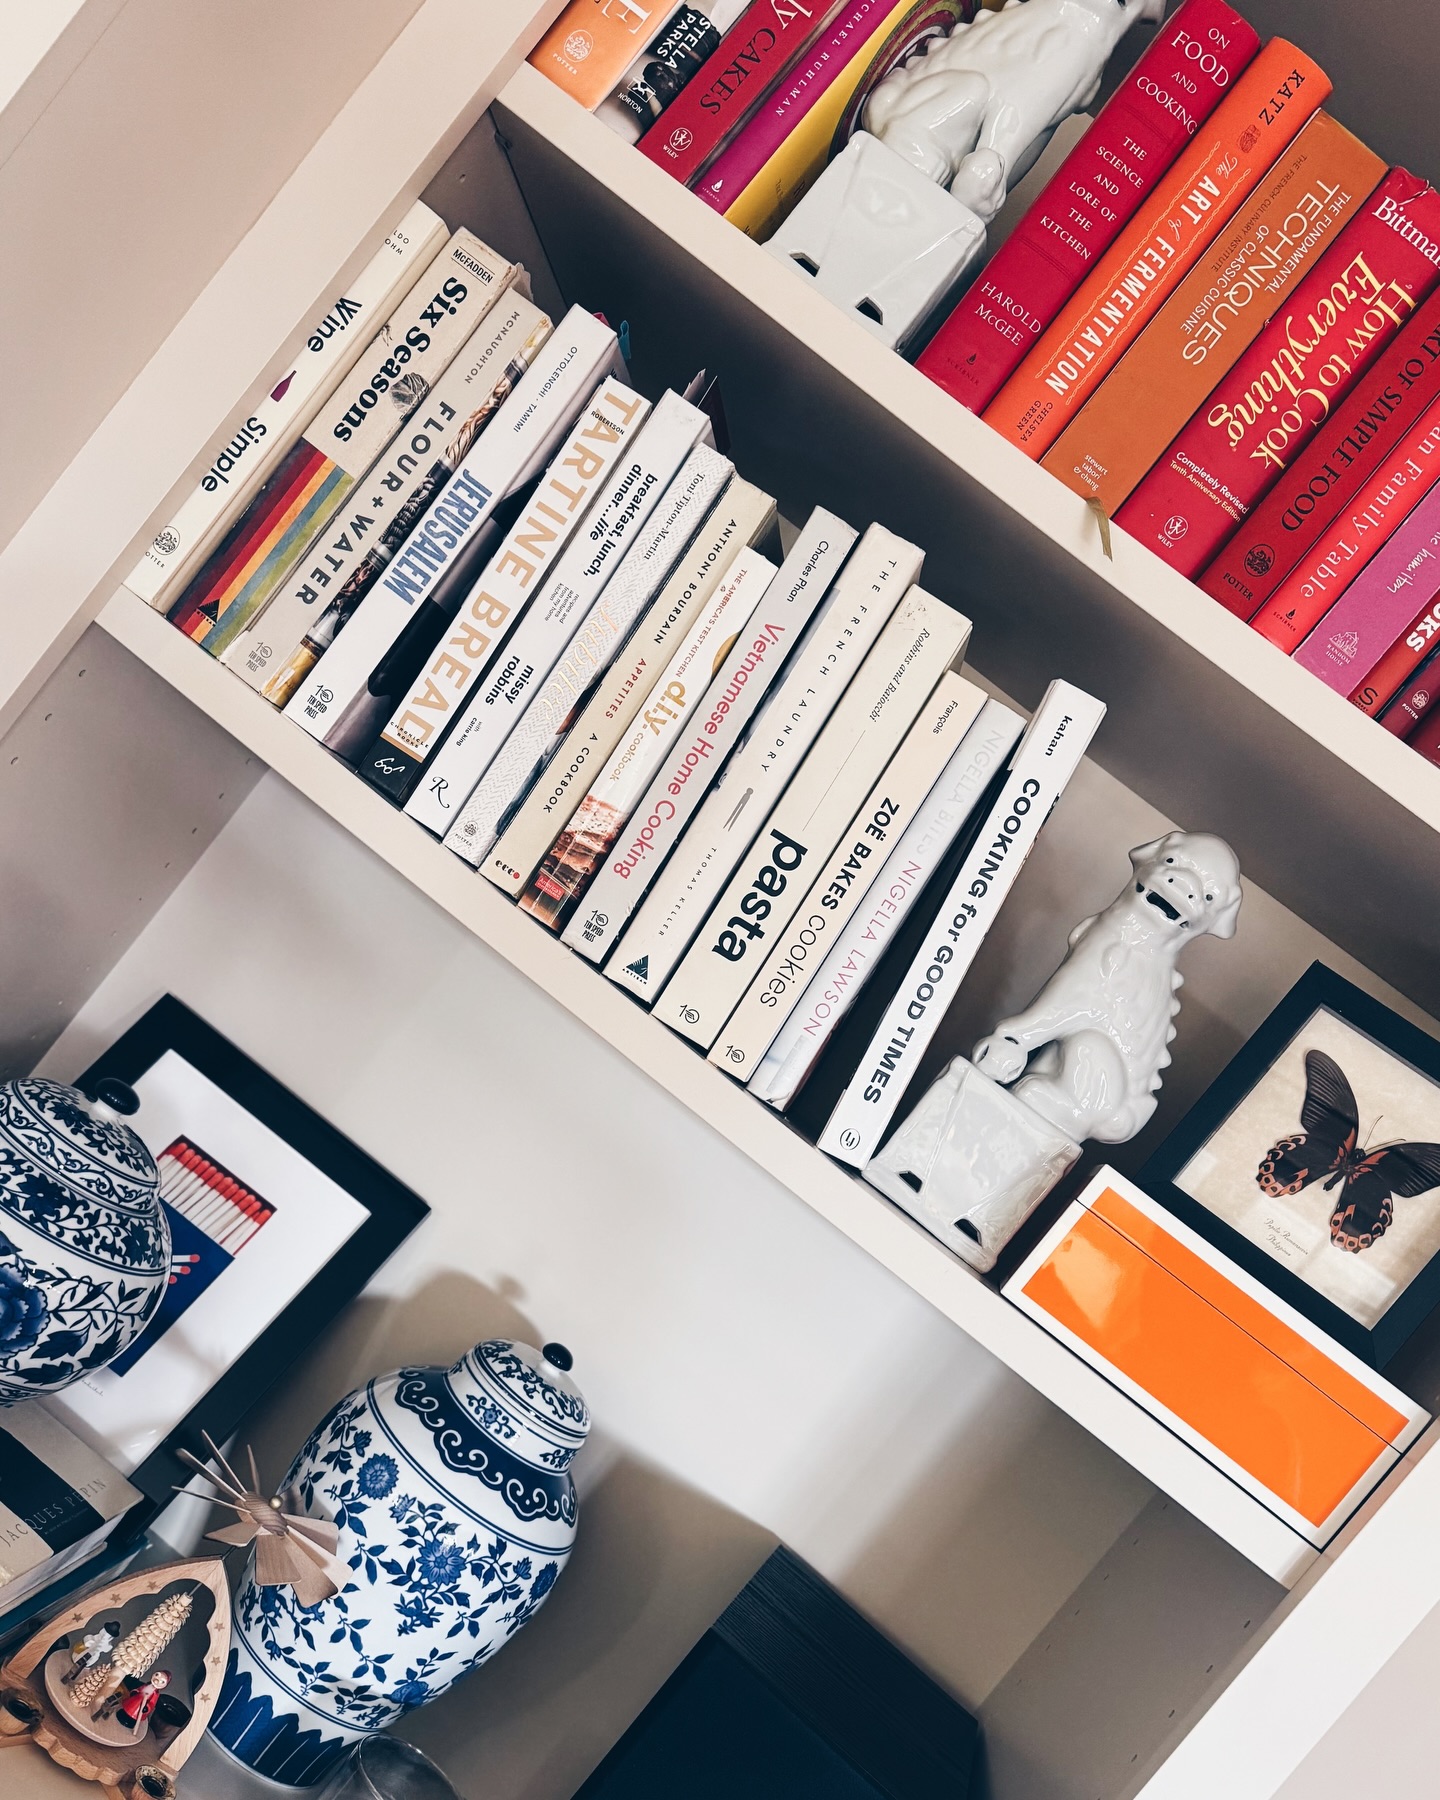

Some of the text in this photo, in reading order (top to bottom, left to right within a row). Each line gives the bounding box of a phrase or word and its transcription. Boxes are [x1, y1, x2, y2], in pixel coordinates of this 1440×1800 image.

[656, 12, 697, 57] PARKS
[665, 17, 711, 69] STELLA
[1171, 31, 1229, 87] FOOD
[1208, 28, 1230, 49] ON
[700, 28, 776, 115] CAKES
[775, 52, 830, 117] RUHLMAN
[1171, 72, 1197, 94] AND
[617, 92, 643, 114] NORTON
[1136, 76, 1199, 135] COOKING
[1258, 69, 1306, 126] KATZ
[662, 144, 679, 159] WILEY
[1096, 146, 1144, 189] SCIENCE
[1122, 136, 1147, 161] THE
[1069, 181, 1117, 223] LORE OF
[1093, 173, 1120, 196] AND
[1040, 216, 1092, 261] KITCHEN
[1068, 208, 1093, 231] THE
[1211, 154, 1308, 273] THE FRENCH CULINARY INSTITUTE
[452, 248, 494, 284] MCFADDEN
[1264, 191, 1352, 294] THE FUNDAMENTAL
[1045, 152, 1239, 396] The ART of FERMENTATION
[1180, 225, 1270, 335] OF CLASSIC CUISINE
[1182, 180, 1341, 366] TECHNIQUES
[974, 304, 1024, 346] McGEE
[981, 282, 1041, 333] HAROLD
[333, 277, 468, 442] Six Seasons
[464, 311, 521, 385] MCNAUGHTON
[1207, 250, 1387, 448] Everything
[201, 297, 363, 492] Wine Simple
[513, 346, 578, 433] OTTOLENGHI TAMIMI
[1249, 278, 1418, 470] How to Cook
[590, 410, 625, 436] ROBERTSON
[1016, 400, 1042, 431] GREEN
[1020, 402, 1054, 442] CHELSEA
[1084, 454, 1108, 476] stewart
[1281, 357, 1425, 531] OF SIMPLE FOOD
[1080, 472, 1099, 492] chang
[1081, 463, 1102, 481] tabori
[1170, 459, 1241, 523] Tenth Anniversary Edition
[1176, 451, 1250, 515] Completely Revised
[295, 401, 457, 605] FLOUR + WATER
[583, 473, 658, 577] breakfast, lunch,
[643, 472, 706, 561] Toni Tipton-Martin
[1300, 458, 1425, 599] Family Table
[382, 469, 493, 606] JERUSALEM
[1157, 533, 1175, 549] WILEY
[398, 391, 643, 744] TARTINE BREAD
[653, 518, 738, 644] ANTHONY BOURDAIN
[786, 539, 829, 603] Charles Phan
[1222, 572, 1255, 601] POTTER
[675, 569, 748, 678] THE AMERICA'S TEST KITCHEN
[1273, 611, 1297, 632] SCRIBNER
[245, 660, 258, 673] PRESS
[248, 650, 267, 668] TEN SPEED
[544, 603, 618, 721] Jubilee
[761, 559, 898, 772] THE FRENCH LAUNDRY
[869, 627, 931, 723] Robbins and Baiocchi
[1325, 650, 1344, 667] HOUSE
[1326, 643, 1351, 665] RANDOM
[307, 694, 328, 715] TEN SPEED
[485, 655, 521, 706] robbins
[505, 664, 535, 705] missy
[605, 658, 648, 719] APPETITES
[303, 706, 318, 720] PRESS
[390, 721, 430, 749] CHRONICLE
[456, 717, 478, 747] carrie king
[932, 700, 959, 735] François
[1045, 714, 1073, 757] kahan
[1402, 702, 1419, 720] POTTER
[542, 732, 599, 814] A COOKBOOK
[609, 732, 644, 782] cookbook
[613, 623, 786, 880] Vietnamese Home Cooking
[428, 776, 450, 809] R
[916, 729, 1006, 855] NIGELLA BITES
[658, 846, 717, 936] THOMAS KELLER
[711, 828, 809, 962] pasta
[760, 796, 901, 1008] ZOË BAKES cookies
[581, 929, 597, 943] PRESS
[583, 920, 604, 937] TEN SPEED
[803, 860, 923, 1036] NIGELLA LAWSON
[863, 778, 1041, 1104] COOKING for GOOD TIMES
[0, 1503, 64, 1548] JACQUES
